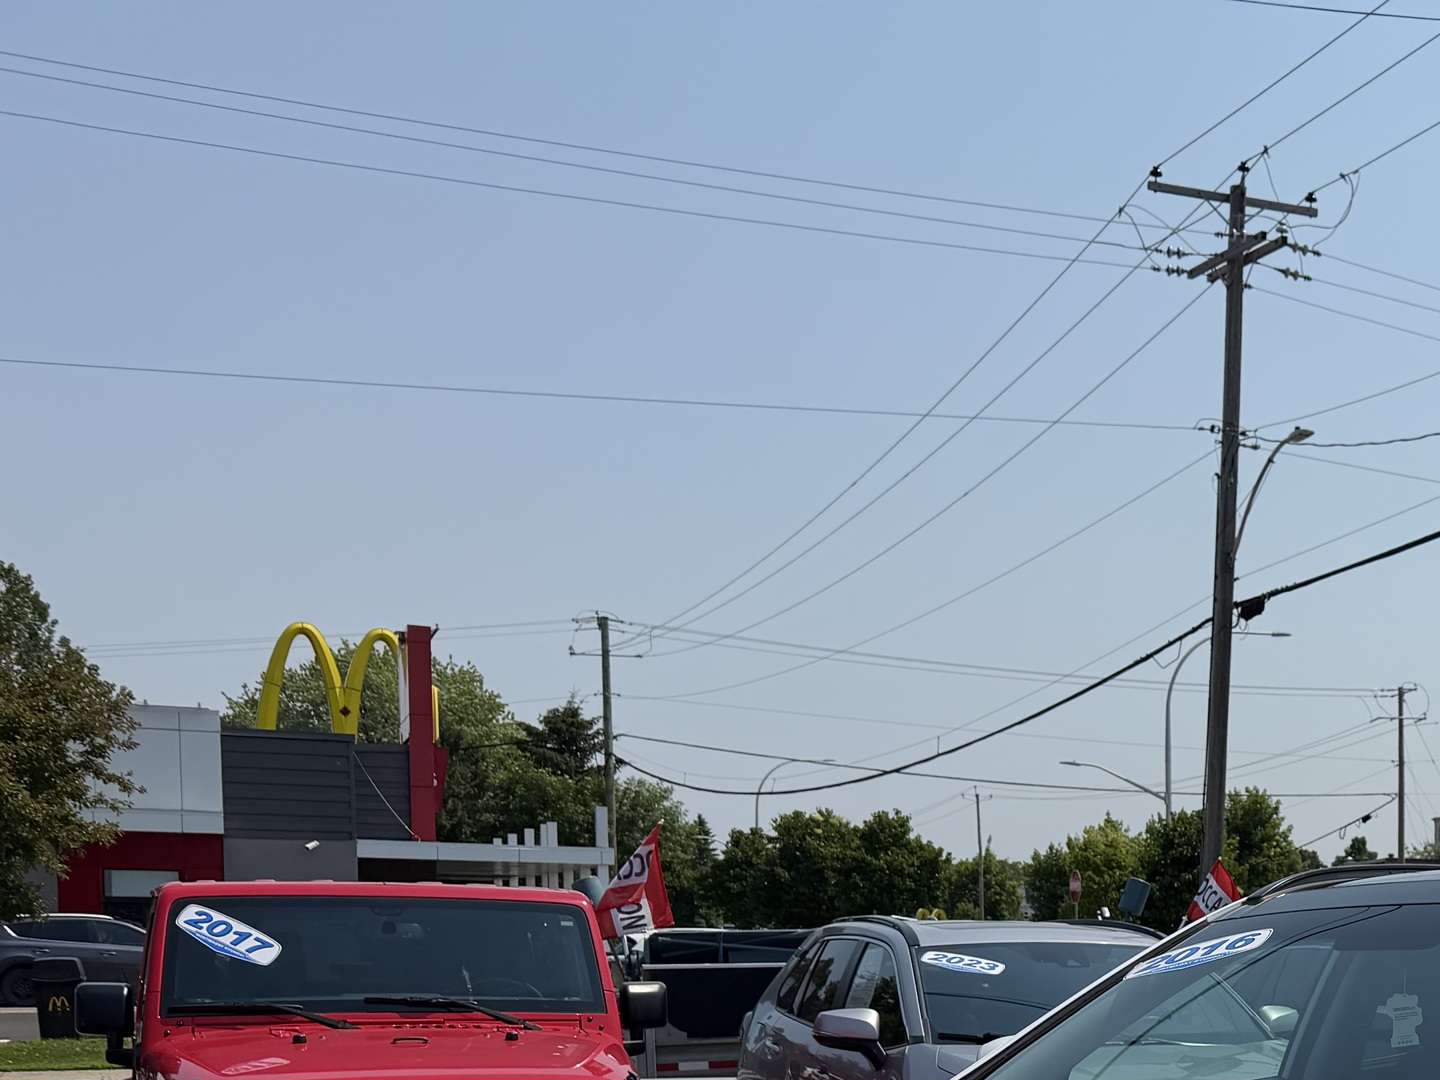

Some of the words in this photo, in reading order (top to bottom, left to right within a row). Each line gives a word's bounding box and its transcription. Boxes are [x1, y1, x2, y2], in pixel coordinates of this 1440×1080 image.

[183, 910, 275, 954] 2017
[1144, 932, 1262, 970] 2016
[926, 953, 1000, 971] 2023
